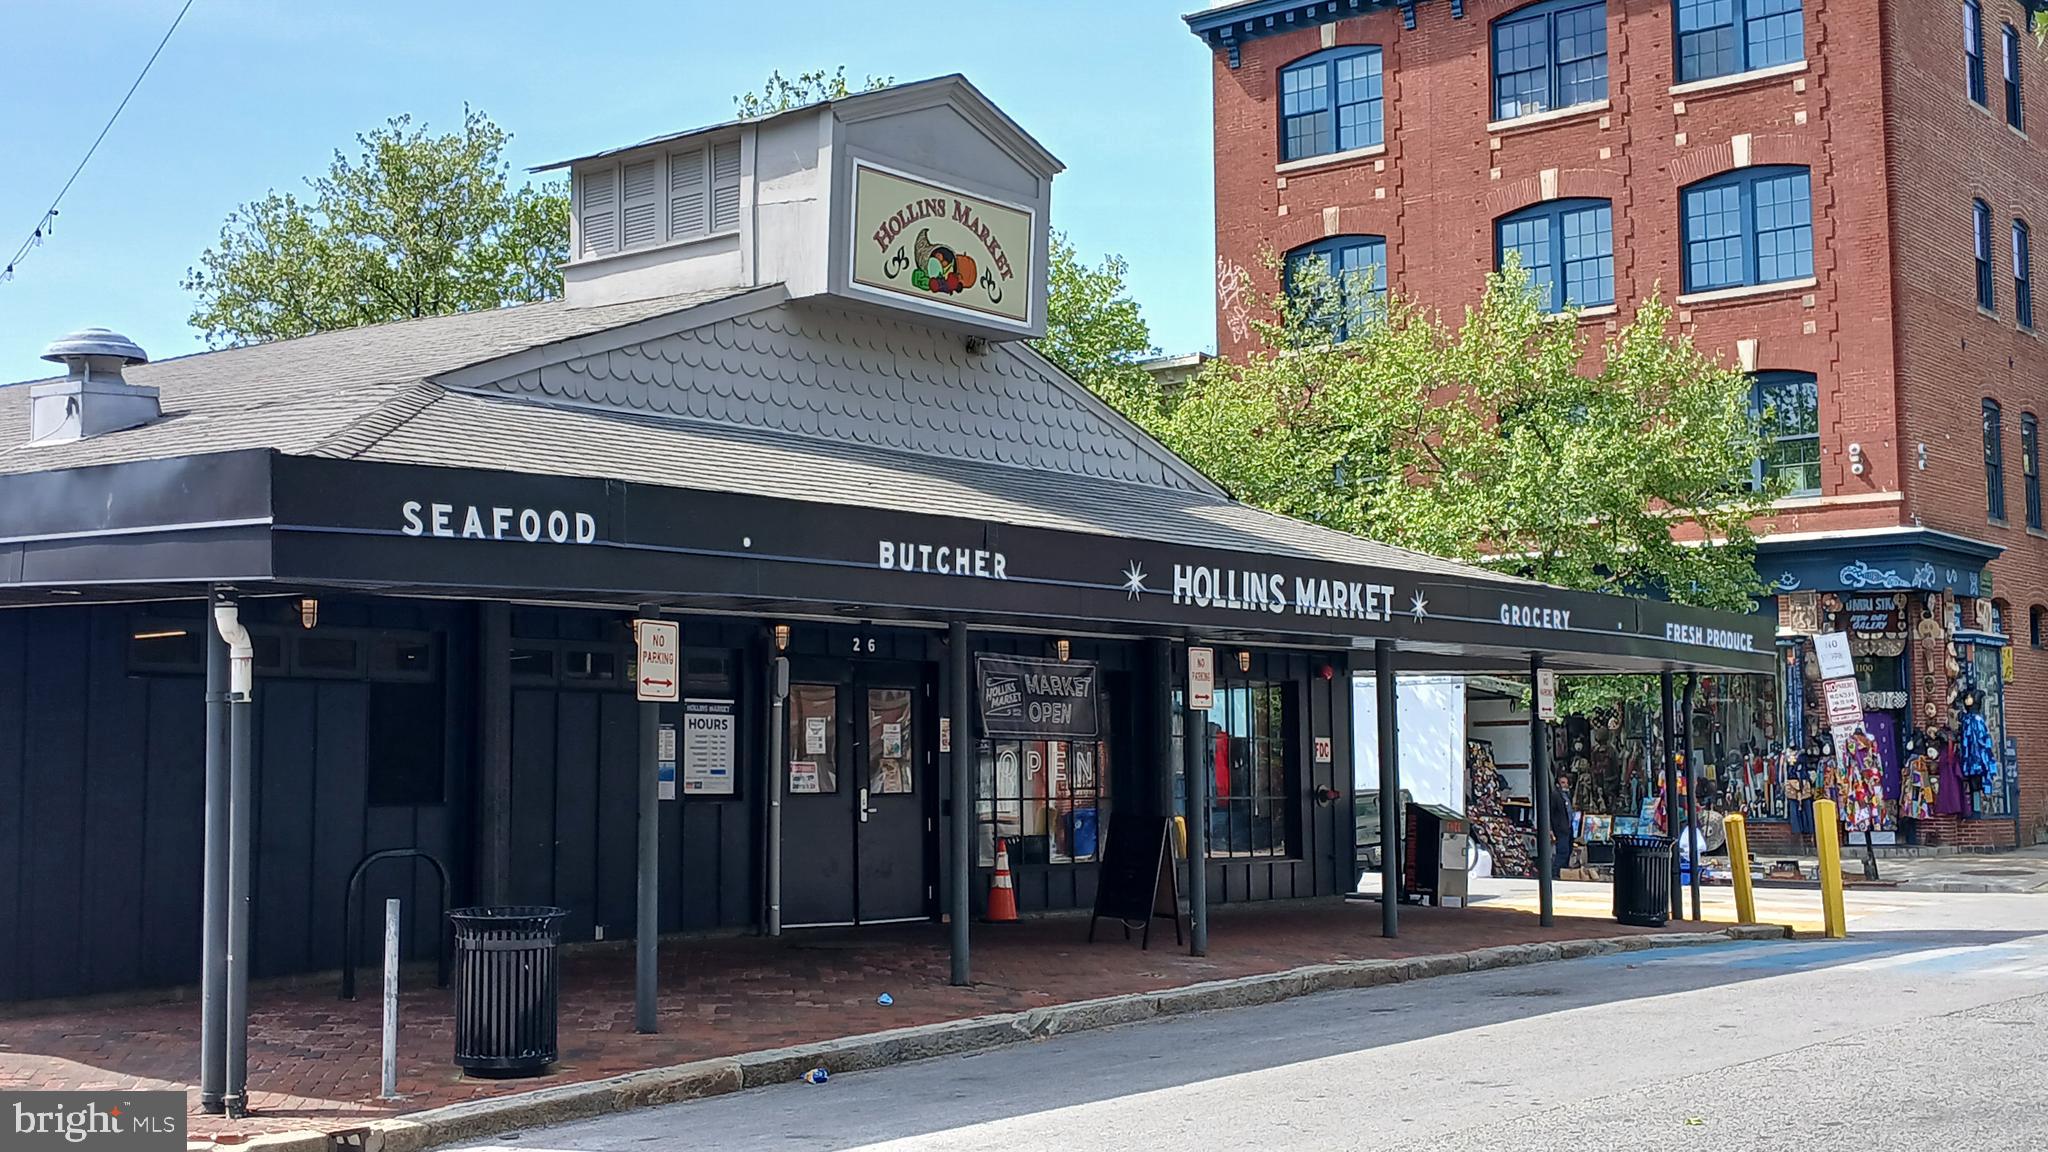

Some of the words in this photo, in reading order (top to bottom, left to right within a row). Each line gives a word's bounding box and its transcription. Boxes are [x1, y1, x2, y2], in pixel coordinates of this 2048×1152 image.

[872, 198, 946, 254] HOLLINS
[952, 199, 1015, 282] MARKET
[402, 501, 596, 544] SEAFOOD
[879, 540, 1008, 580] BUTCHER
[1173, 564, 1286, 614] HOLLINS
[1295, 576, 1395, 622] MARKET
[1500, 603, 1571, 631] GROCERY
[652, 634, 665, 648] NO
[1666, 622, 1703, 645] FRESH
[1707, 629, 1754, 651] PRODUCE
[642, 651, 674, 665] PARKING
[1024, 673, 1092, 698] MARKET
[689, 718, 728, 730] HOURS
[1029, 702, 1072, 724] OPEN
[1000, 750, 1092, 781] OPEN
